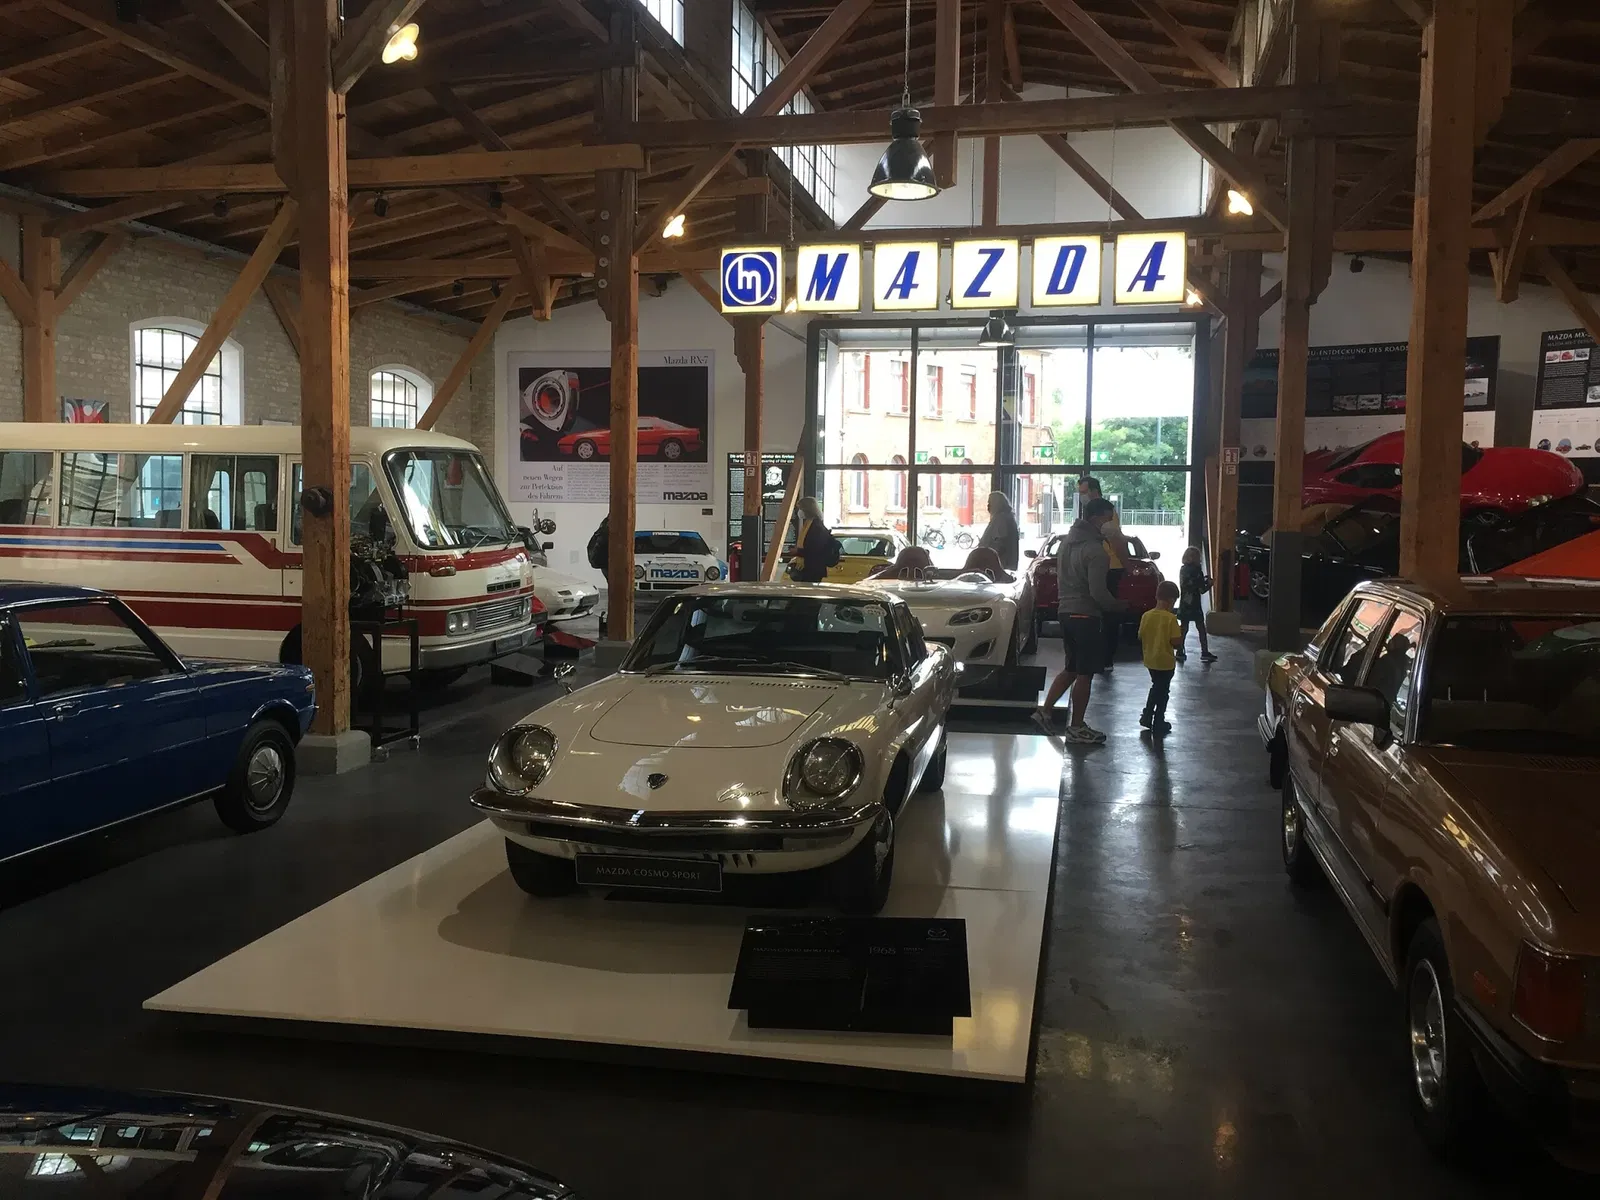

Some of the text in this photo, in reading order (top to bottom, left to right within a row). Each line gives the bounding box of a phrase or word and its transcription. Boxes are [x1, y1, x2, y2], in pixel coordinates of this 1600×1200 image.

[805, 241, 1168, 302] MAZDA
[1547, 333, 1573, 341] MAZDA
[663, 355, 709, 365] Mazda RX-7
[552, 464, 564, 472] Auf
[543, 473, 563, 482] Wegen
[663, 491, 708, 501] mazda
[651, 569, 699, 579] mazda
[595, 866, 701, 880] MAZDA COSMO SPORT
[867, 945, 896, 956] 1968
